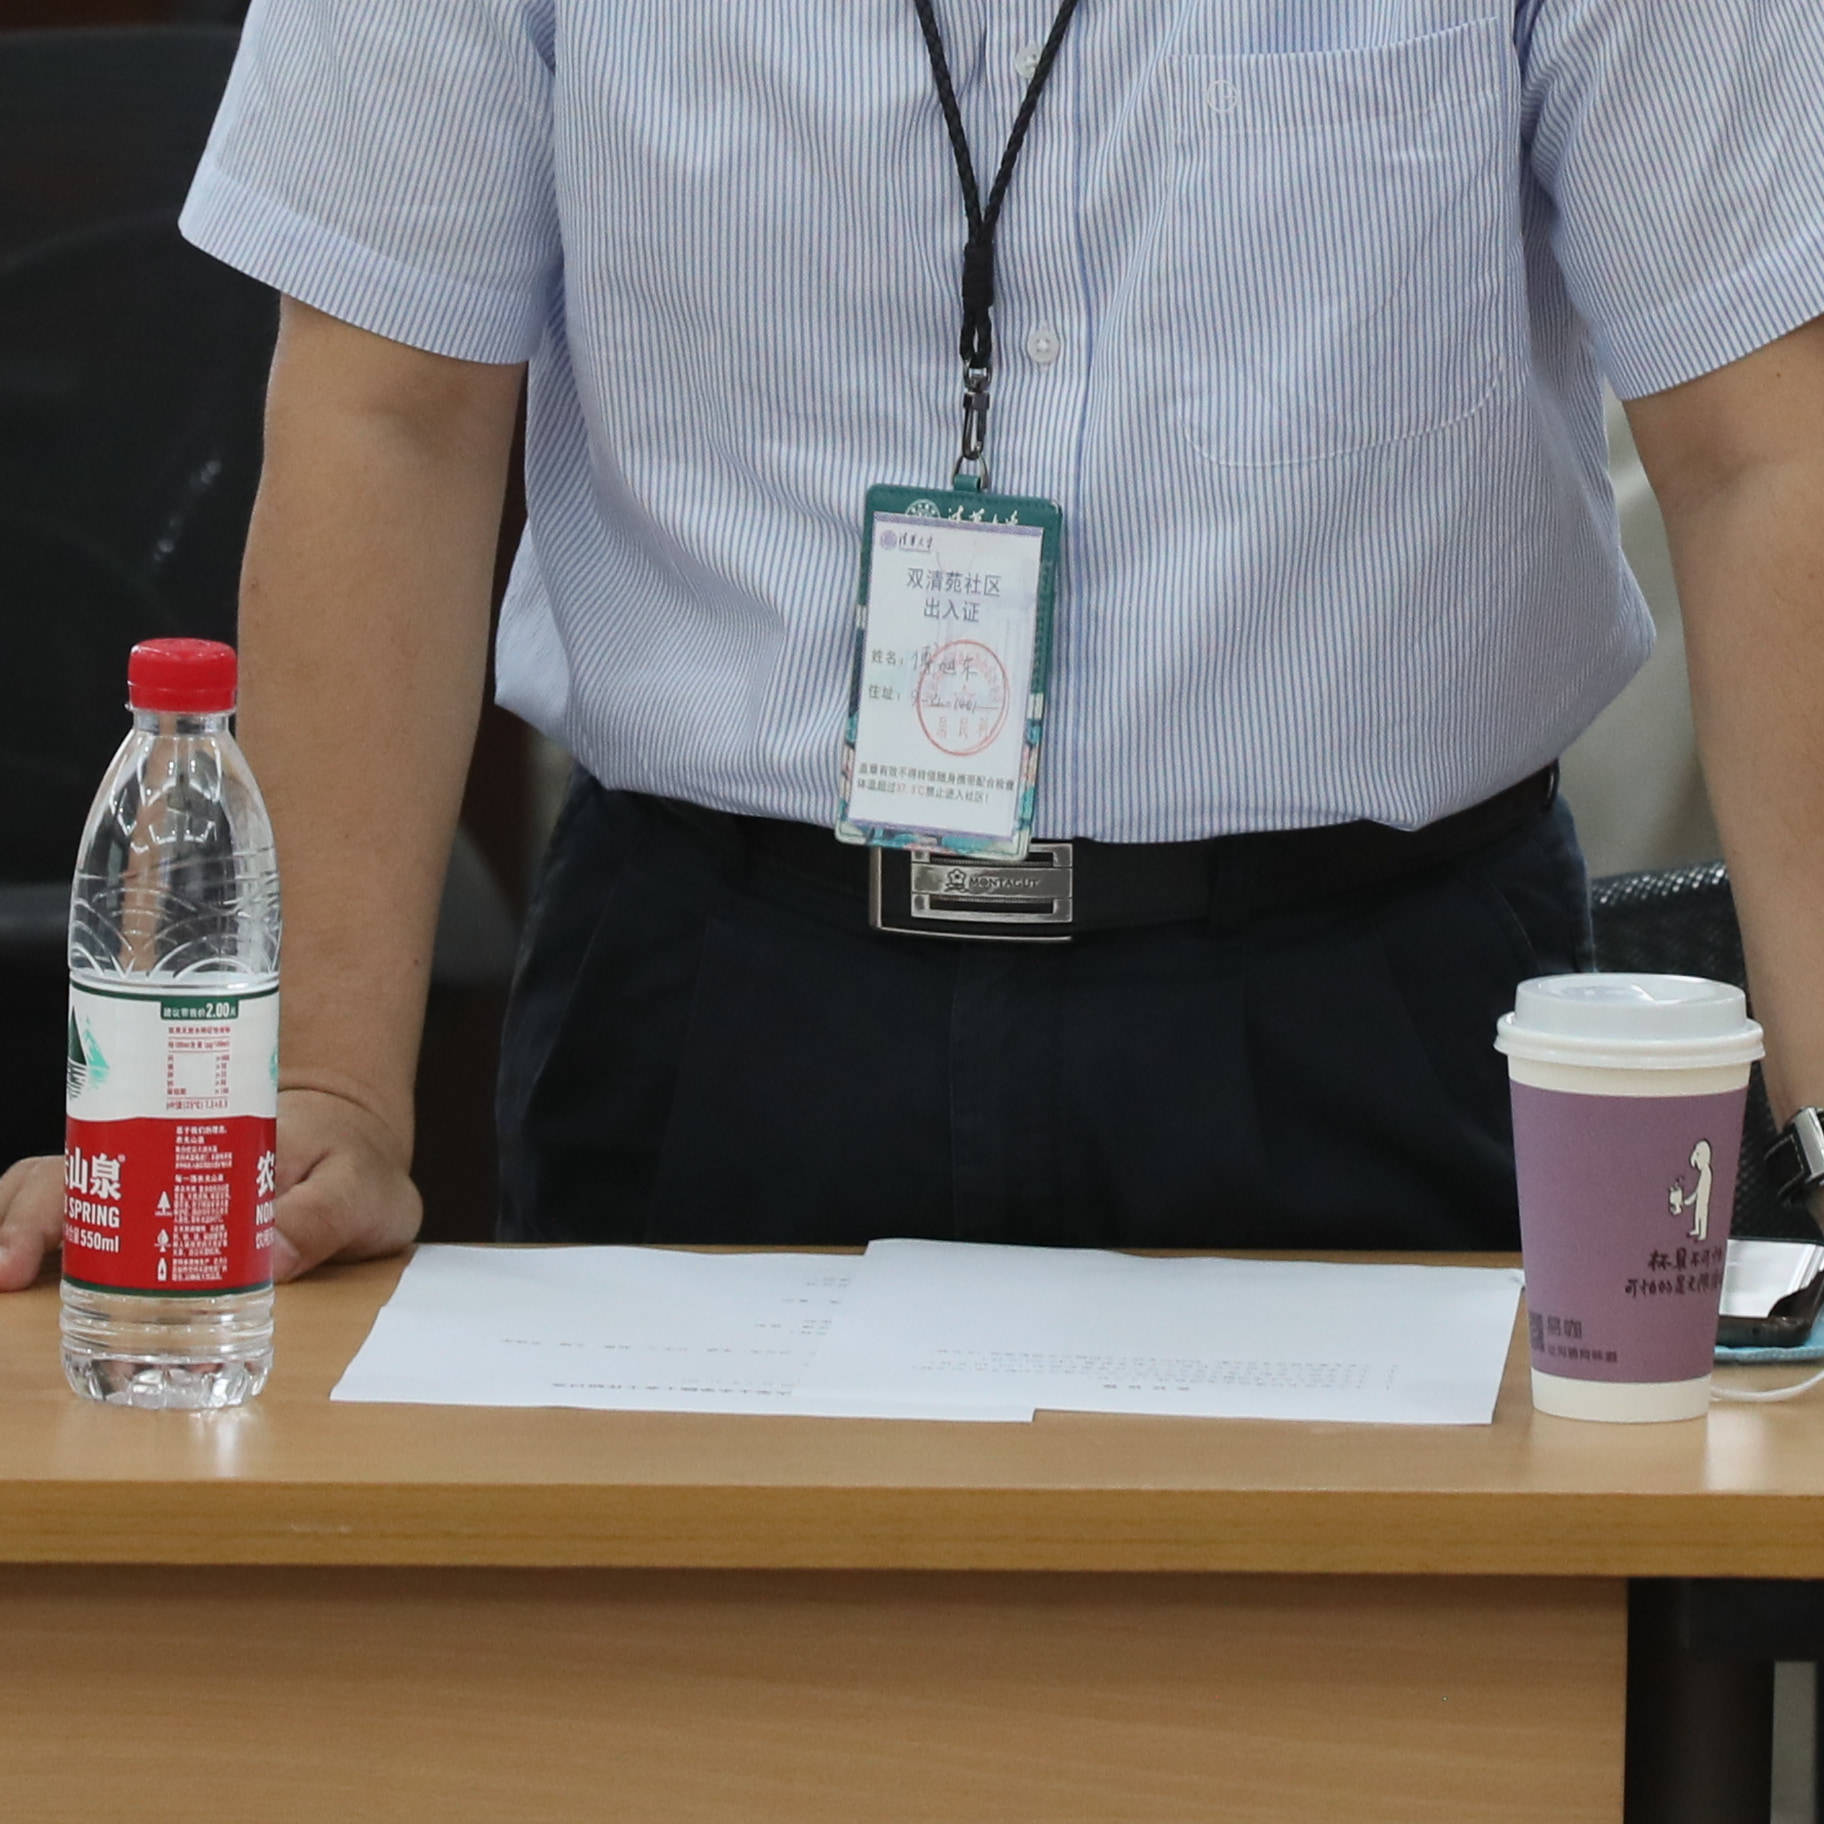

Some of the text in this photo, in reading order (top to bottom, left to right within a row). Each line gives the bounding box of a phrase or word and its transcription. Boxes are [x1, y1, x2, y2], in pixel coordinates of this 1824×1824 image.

[906, 567, 1002, 597] 双清苑社区
[923, 598, 980, 623] 出入证
[968, 876, 1038, 890] MONTAGUT
[68, 1198, 121, 1228] SPRING
